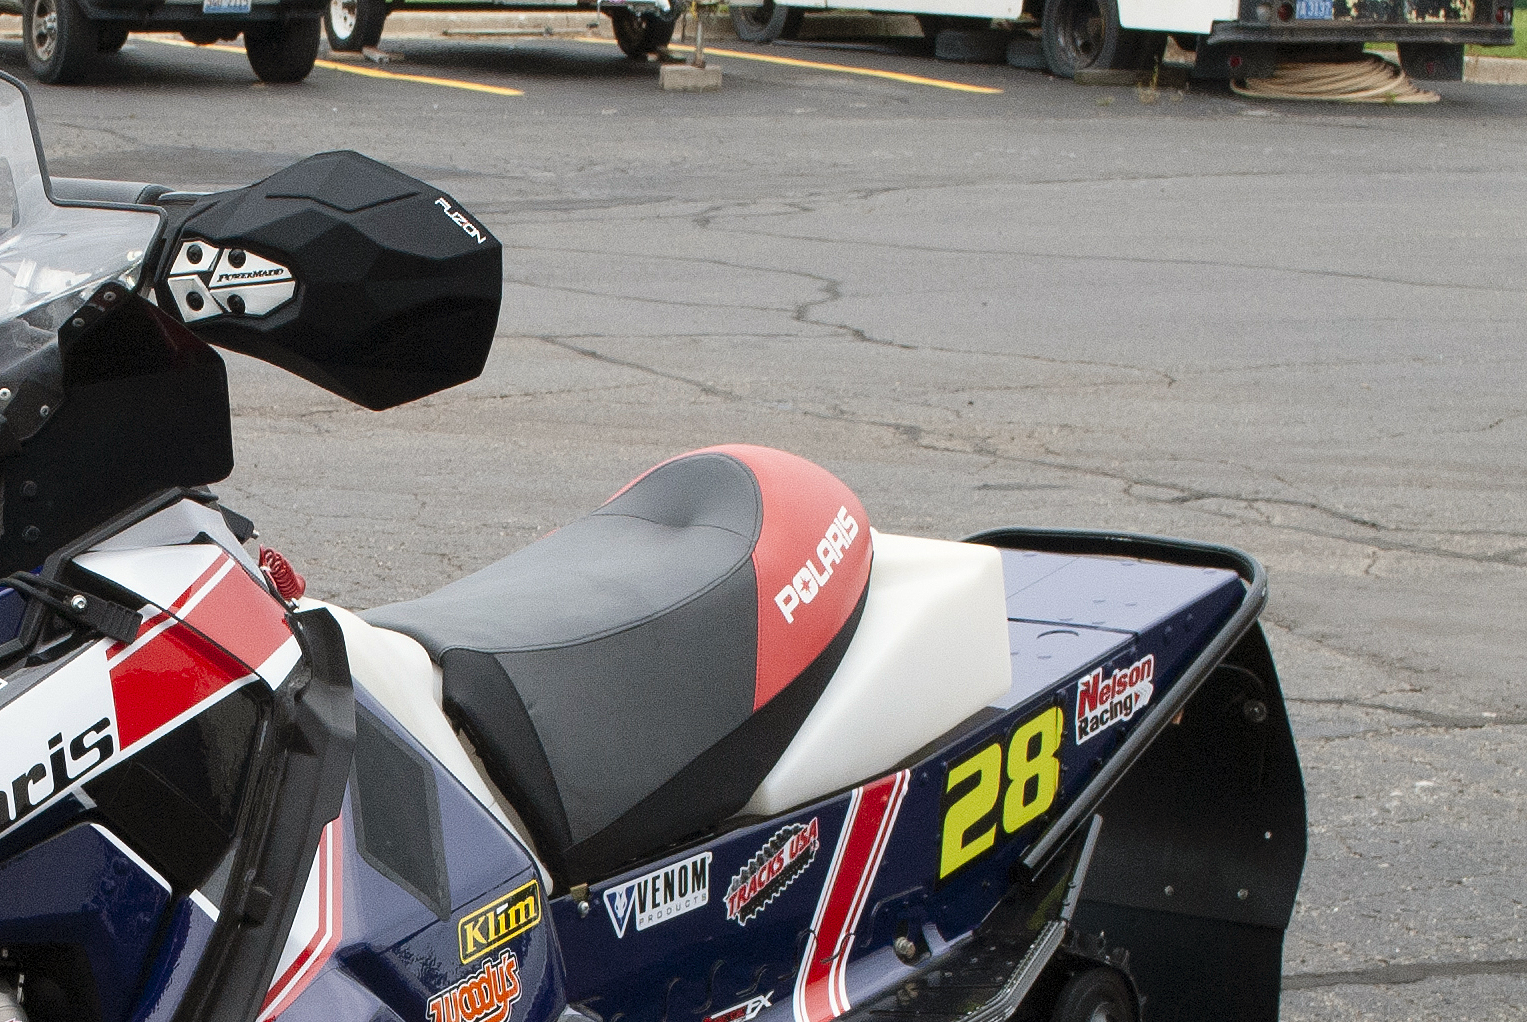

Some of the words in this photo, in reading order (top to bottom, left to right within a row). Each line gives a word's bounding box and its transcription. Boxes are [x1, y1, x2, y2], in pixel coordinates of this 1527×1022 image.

[774, 505, 859, 625] POLARIS
[1078, 658, 1152, 719] Nelson
[1078, 692, 1134, 740] Racing
[940, 705, 1064, 880] 28
[637, 856, 707, 914] VENOM
[727, 848, 785, 918] TRACKS
[789, 818, 818, 861] USA
[464, 895, 537, 955] Klim
[639, 893, 707, 926] PRODUCTS
